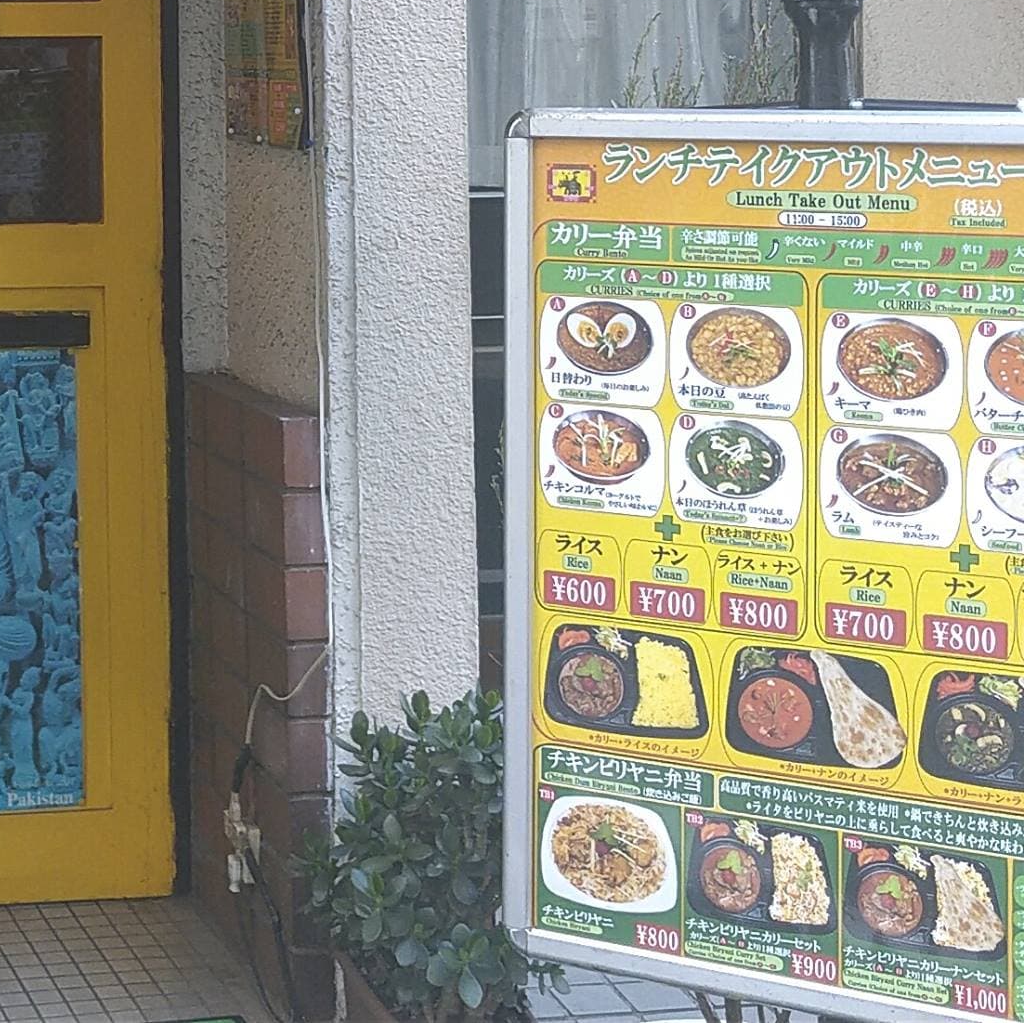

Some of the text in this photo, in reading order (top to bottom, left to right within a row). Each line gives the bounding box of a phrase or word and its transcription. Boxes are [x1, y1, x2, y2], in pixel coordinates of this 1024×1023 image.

[602, 142, 1024, 192] ランチテイクアウトメニュー
[736, 192, 910, 211] Lunch Take Out Menu
[550, 222, 663, 250] カリー弁当
[837, 238, 874, 250] マイルド
[577, 248, 600, 258] Curry
[563, 266, 616, 282] カリーズ
[683, 272, 707, 288] より
[590, 284, 633, 296] CURRIES
[853, 279, 1015, 301] カリーズ より
[883, 298, 931, 311] CURRIES
[551, 372, 592, 386] 日替わり
[678, 384, 726, 399] 本日の豆
[834, 397, 871, 410] キーマ
[543, 480, 606, 496] チキンコルマ
[831, 511, 855, 524] ラム
[555, 536, 603, 555] ライス
[651, 546, 689, 565] ナン
[566, 557, 589, 569] Rice
[717, 554, 802, 576] ライス ナン
[655, 567, 683, 581] Naan
[839, 565, 893, 588] ライス
[552, 576, 607, 606] ¥600
[856, 589, 881, 604] Rice
[944, 577, 986, 598] ナン
[638, 586, 696, 618] ¥700
[950, 600, 981, 616] Naan
[729, 597, 788, 630] ¥800
[832, 608, 894, 641] ¥700
[932, 621, 996, 653] ¥800
[547, 749, 702, 793] チキンビリヤニ弁当
[7, 791, 74, 807] Pakistan
[542, 904, 615, 928] チキンビリヤニ
[636, 924, 679, 951] ¥800
[791, 953, 837, 981] ¥900
[955, 983, 1007, 1014] ¥1,000
